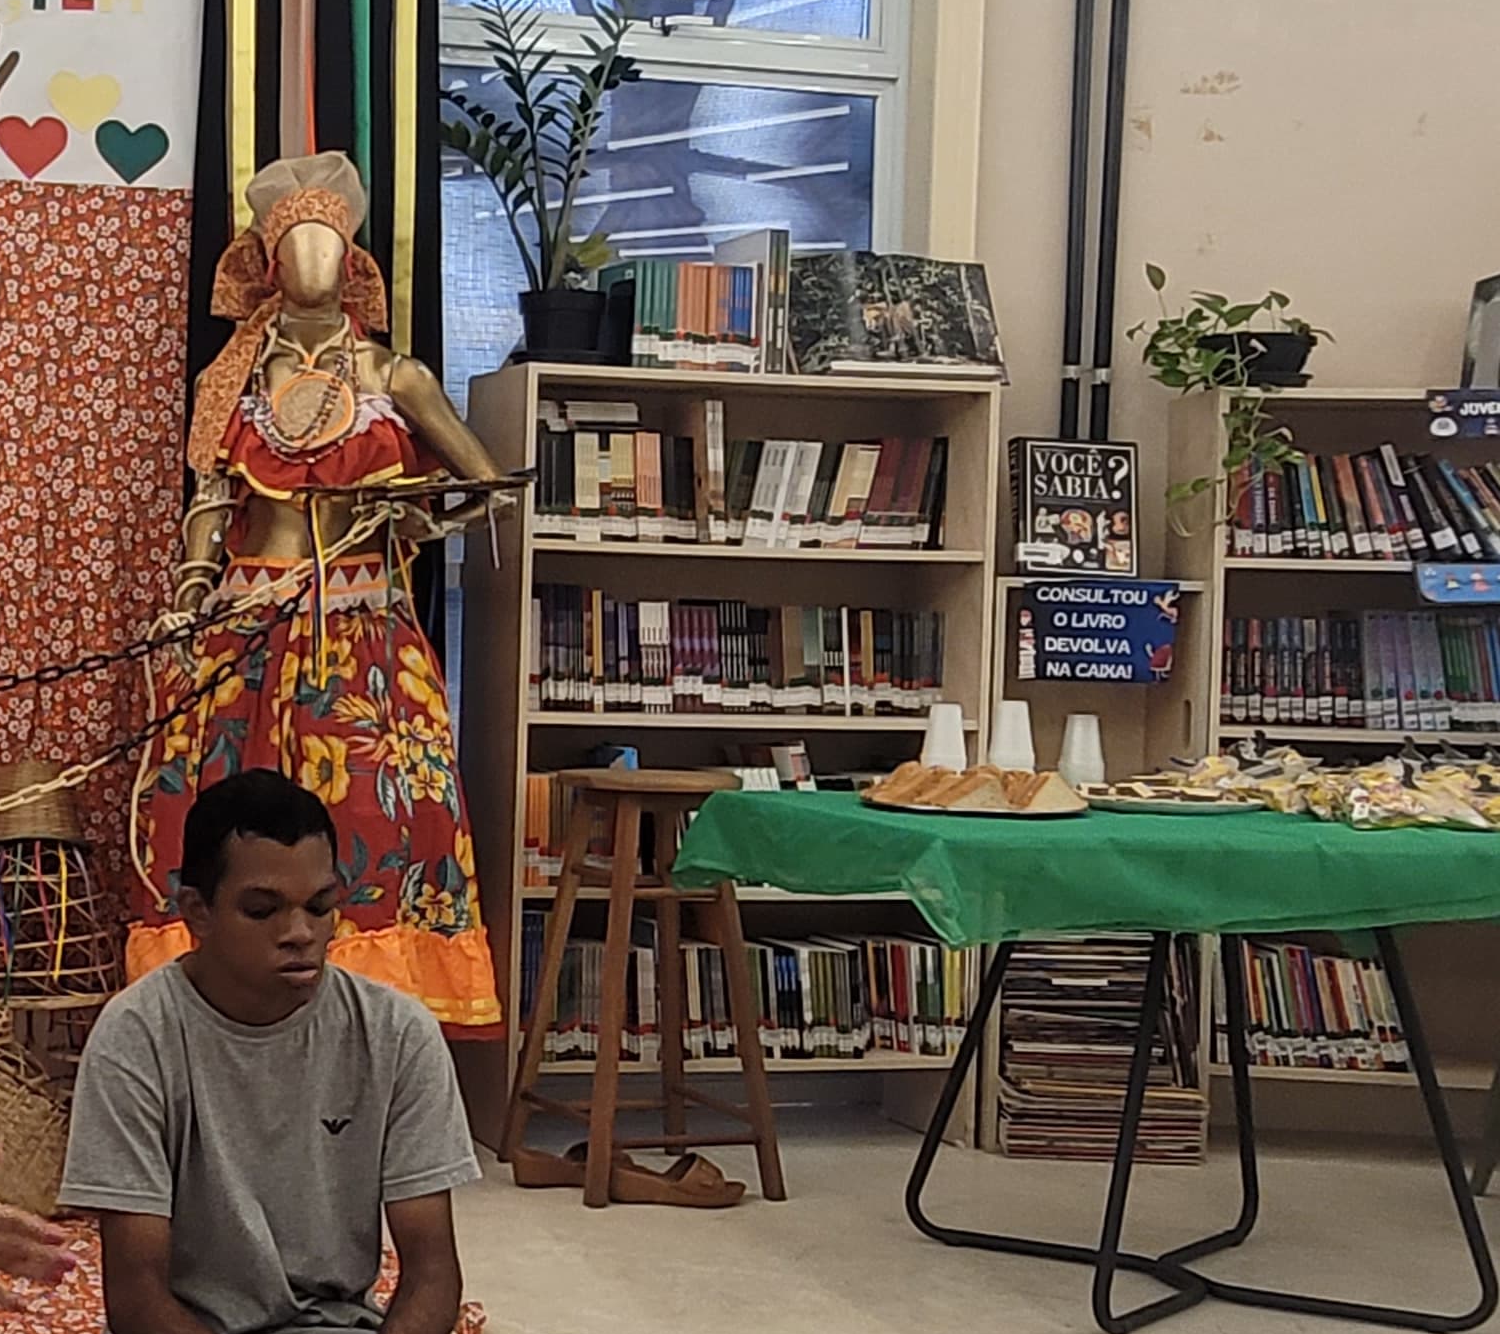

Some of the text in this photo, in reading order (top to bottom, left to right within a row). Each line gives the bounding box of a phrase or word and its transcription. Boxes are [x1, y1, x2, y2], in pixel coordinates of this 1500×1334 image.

[1460, 402, 1500, 416] JOVE
[1034, 449, 1103, 477] VOCÊ
[1034, 474, 1110, 500] SABIA
[1036, 587, 1148, 605] CONSULTOU
[1053, 612, 1126, 629] O LIVRO
[1044, 637, 1131, 654] DEVOLVA
[1046, 662, 1133, 680] NA CAIXA!
